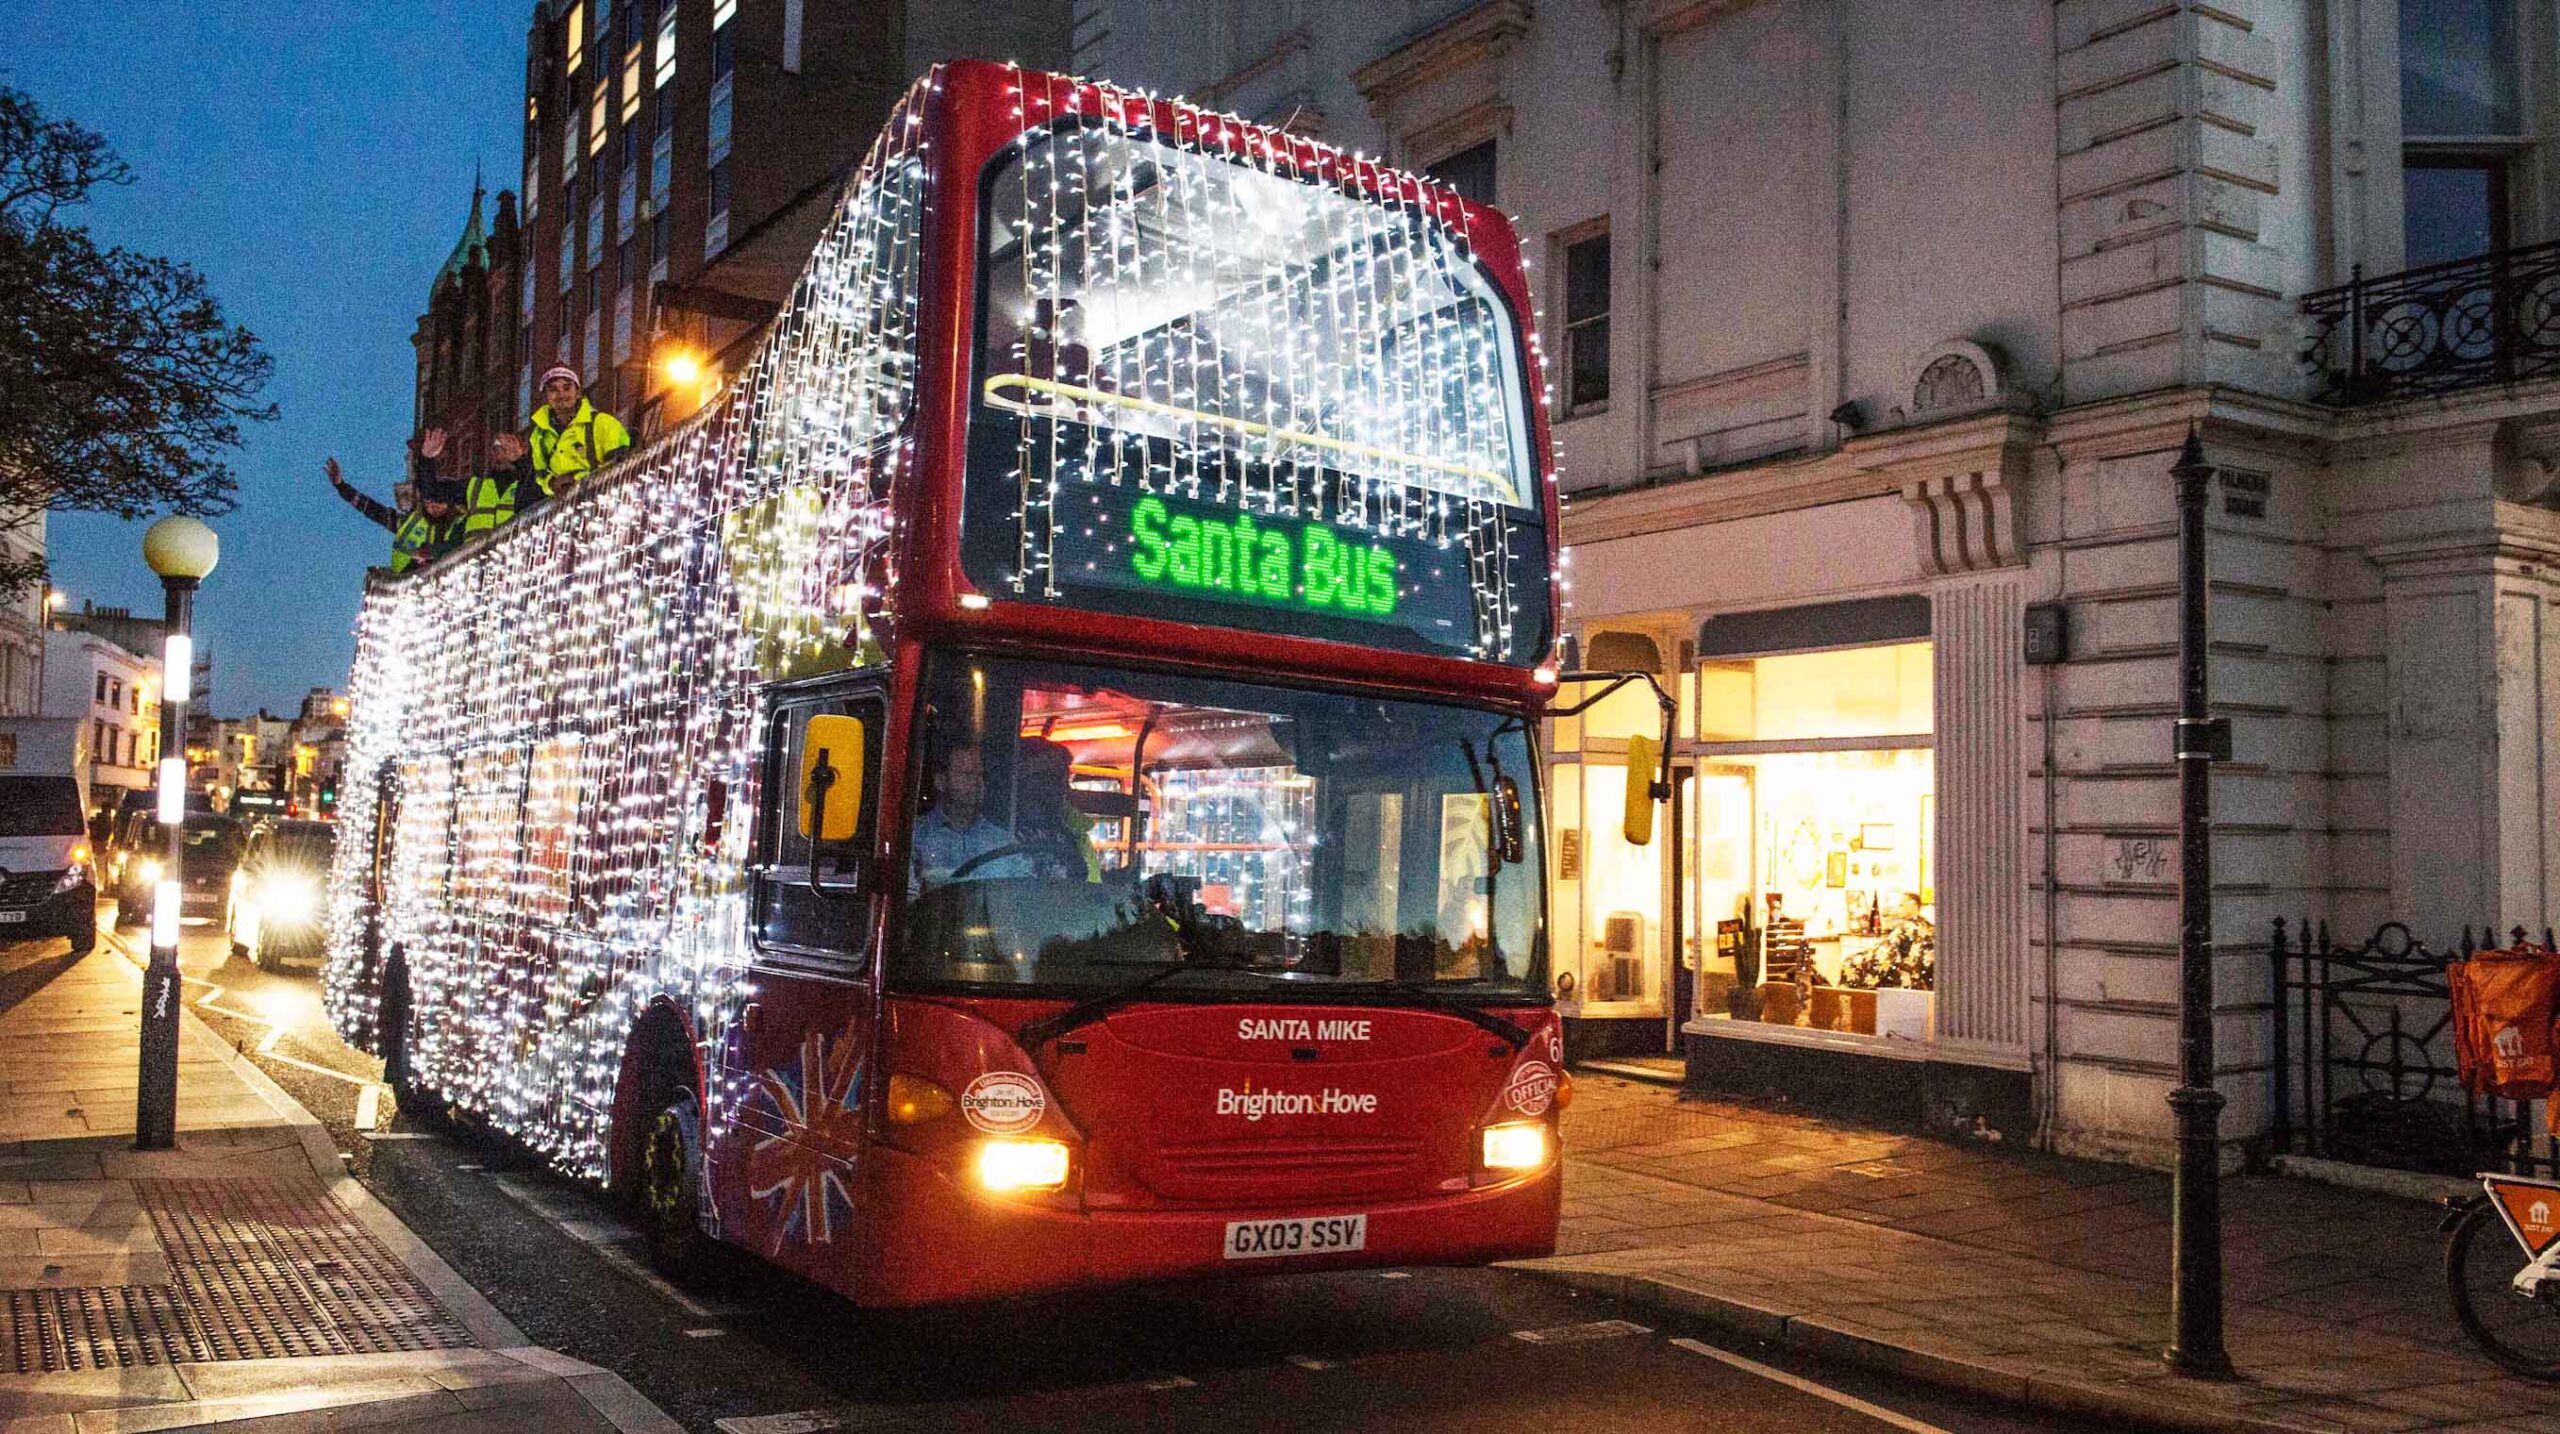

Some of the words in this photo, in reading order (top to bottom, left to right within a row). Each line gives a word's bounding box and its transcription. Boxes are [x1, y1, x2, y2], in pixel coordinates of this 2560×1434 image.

[1132, 497, 1291, 598] Santa
[1304, 523, 1397, 614] Bus
[1238, 1018, 1311, 1040] SANTA
[1317, 1020, 1371, 1041] MIKE
[1235, 1222, 1303, 1252] GX03
[1311, 1219, 1357, 1248] SSV
